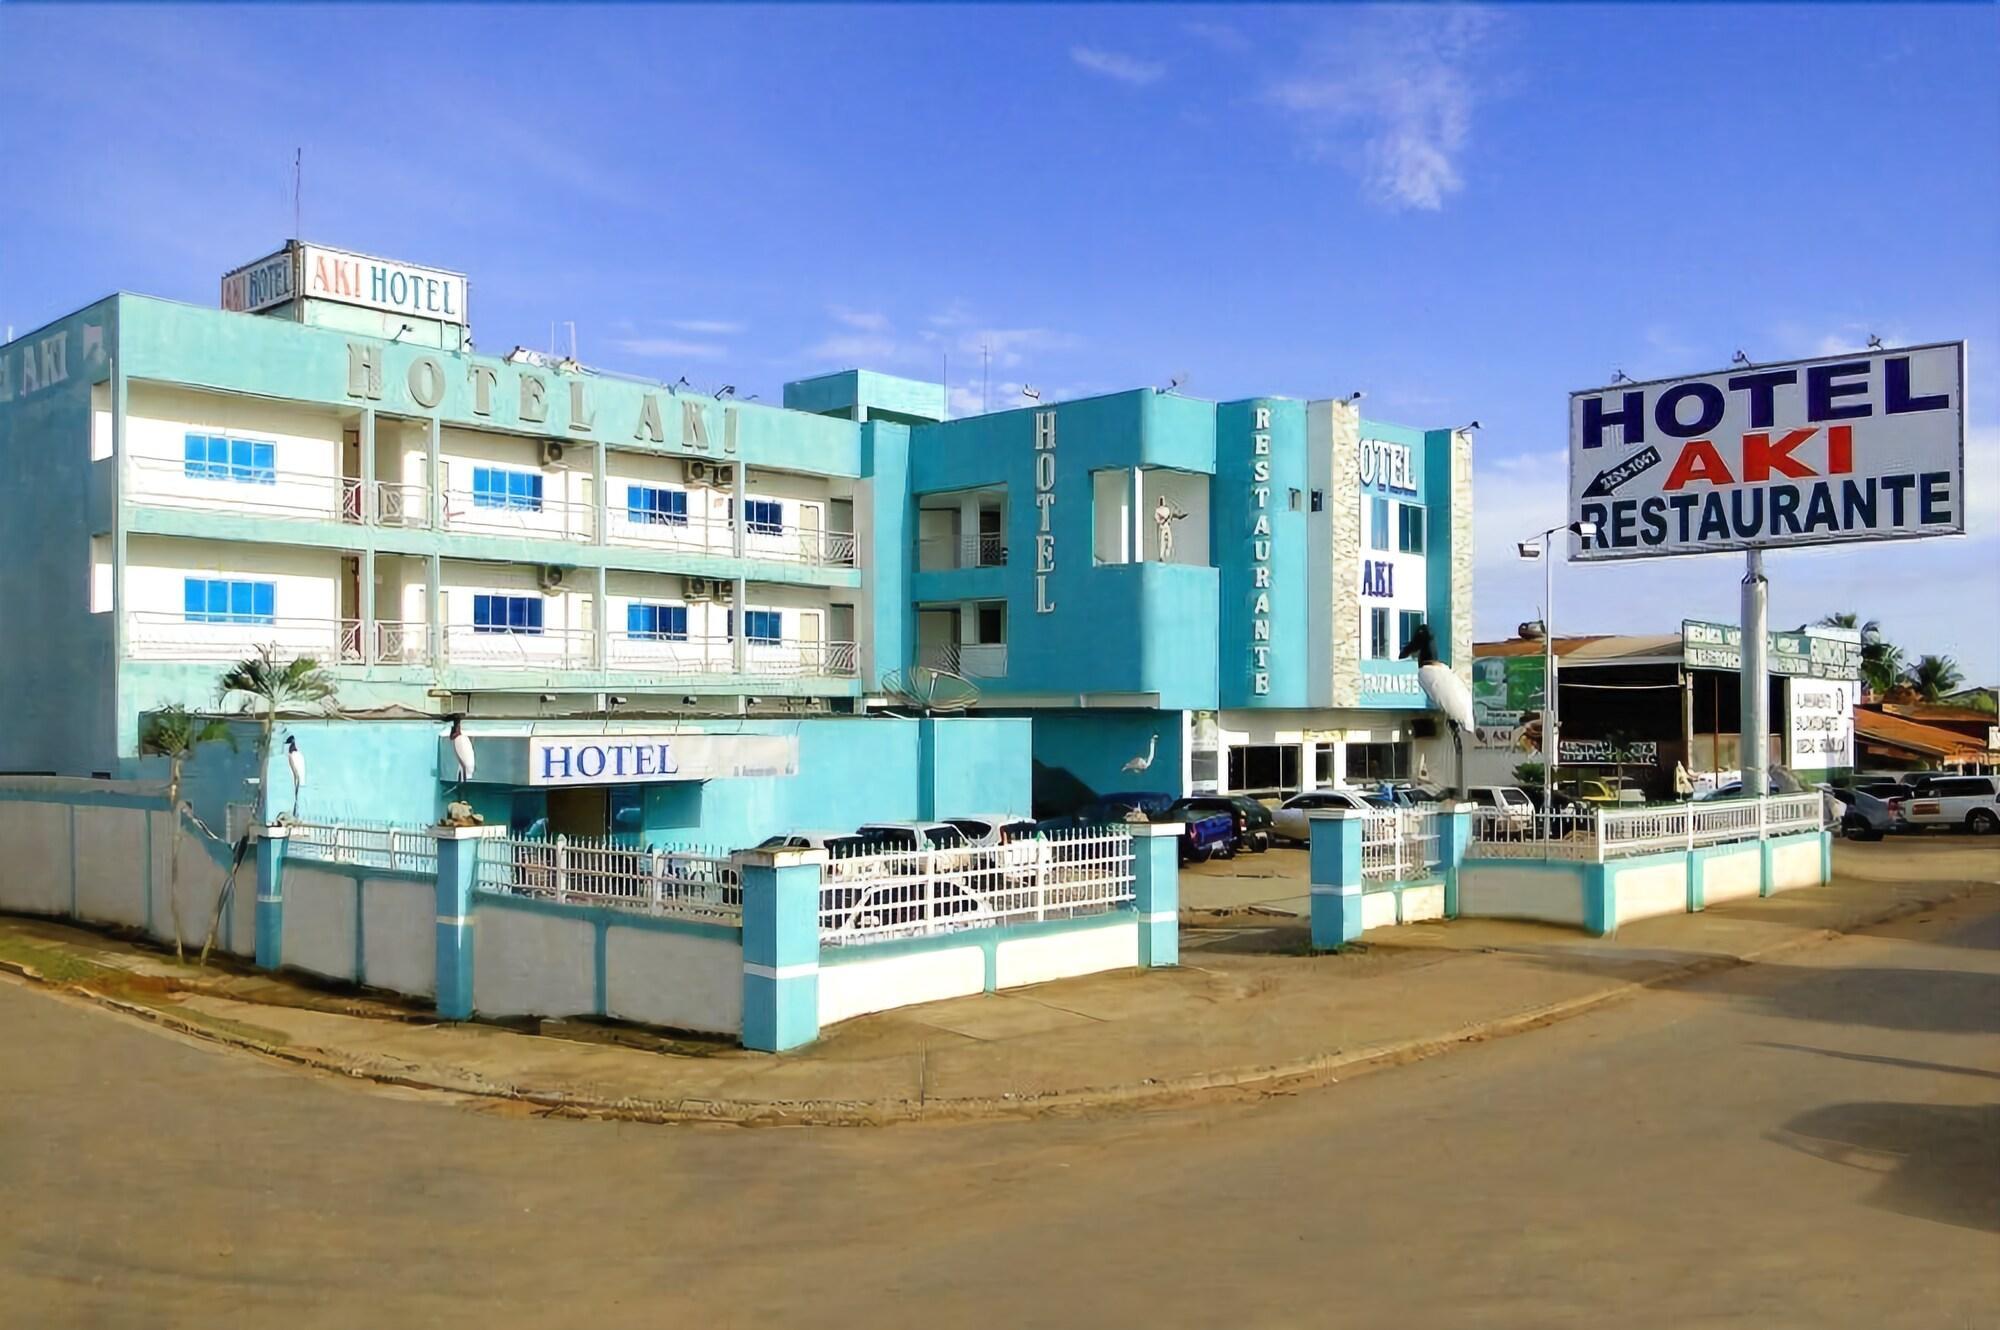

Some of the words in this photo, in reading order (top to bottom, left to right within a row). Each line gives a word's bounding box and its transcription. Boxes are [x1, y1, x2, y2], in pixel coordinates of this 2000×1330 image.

[249, 258, 292, 307] HOTEL
[313, 255, 362, 298] AKI
[371, 265, 456, 315] HOTEL
[20, 330, 70, 397] AKI
[347, 343, 595, 432] HOTEL
[633, 394, 740, 454] AKI
[1582, 357, 1949, 450] HOTEL
[1359, 438, 1418, 497] OTEL
[1662, 425, 1854, 490] AKI
[1034, 411, 1057, 614] HOTEL
[1581, 471, 1952, 550] RESTAURANTE
[1253, 406, 1271, 697] RESTAURANTE
[1362, 559, 1394, 598] AKI
[541, 744, 679, 778] HOTEL
